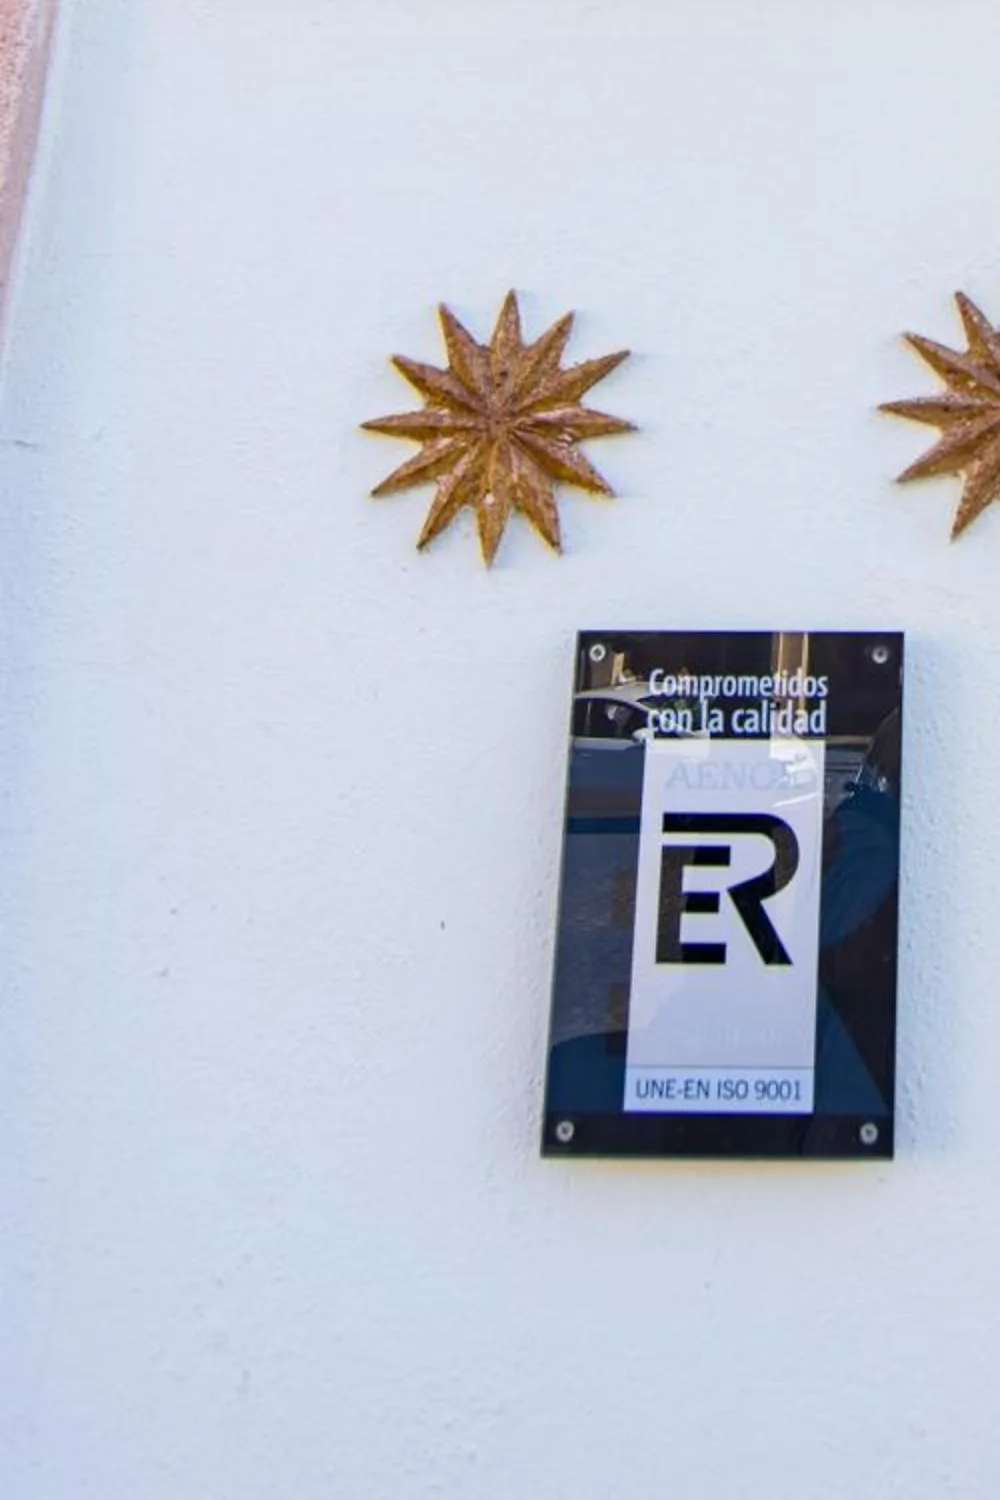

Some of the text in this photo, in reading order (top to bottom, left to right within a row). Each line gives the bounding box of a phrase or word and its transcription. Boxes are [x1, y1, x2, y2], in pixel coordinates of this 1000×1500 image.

[649, 667, 829, 700] Comprometidos
[647, 700, 826, 735] con la calidad
[635, 1078, 802, 1100] UNE-EN ISO 9001
